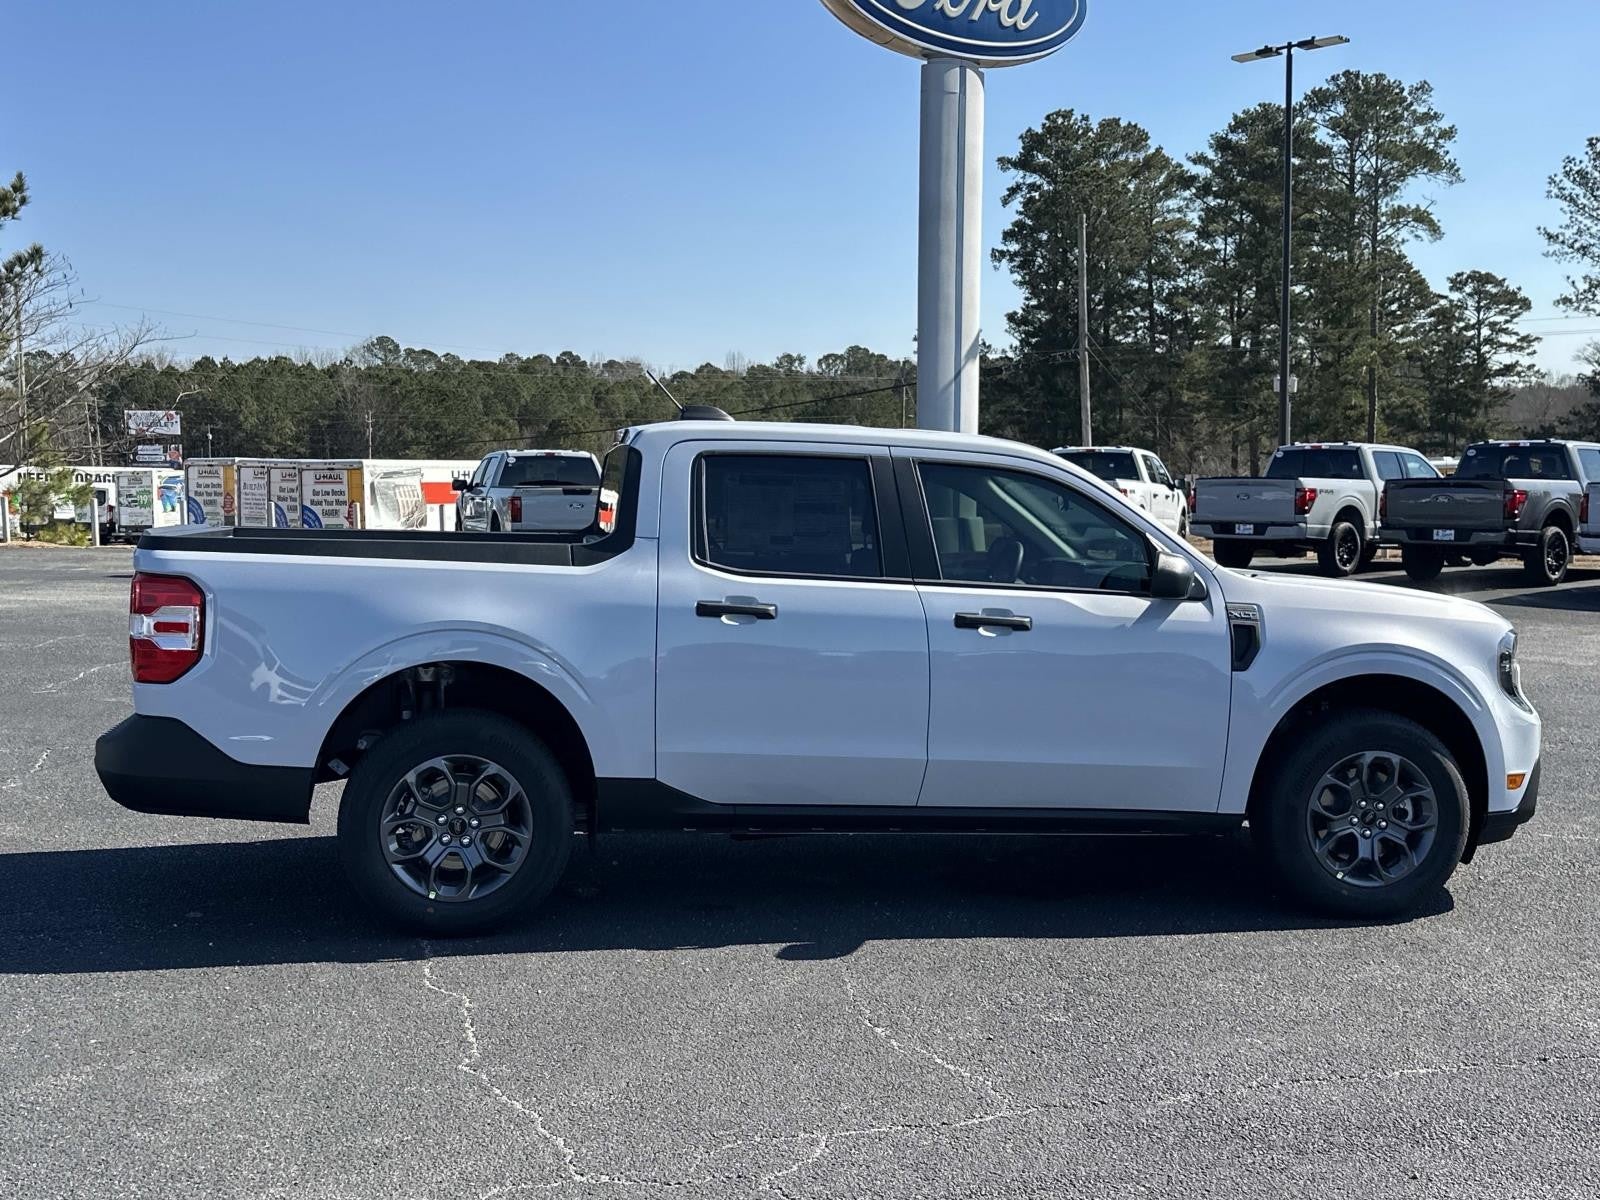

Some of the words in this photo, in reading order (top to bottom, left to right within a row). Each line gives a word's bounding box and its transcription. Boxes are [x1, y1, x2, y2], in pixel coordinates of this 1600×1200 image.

[894, 0, 1040, 31] ord
[451, 470, 472, 480] U-H
[331, 489, 346, 497] Decks
